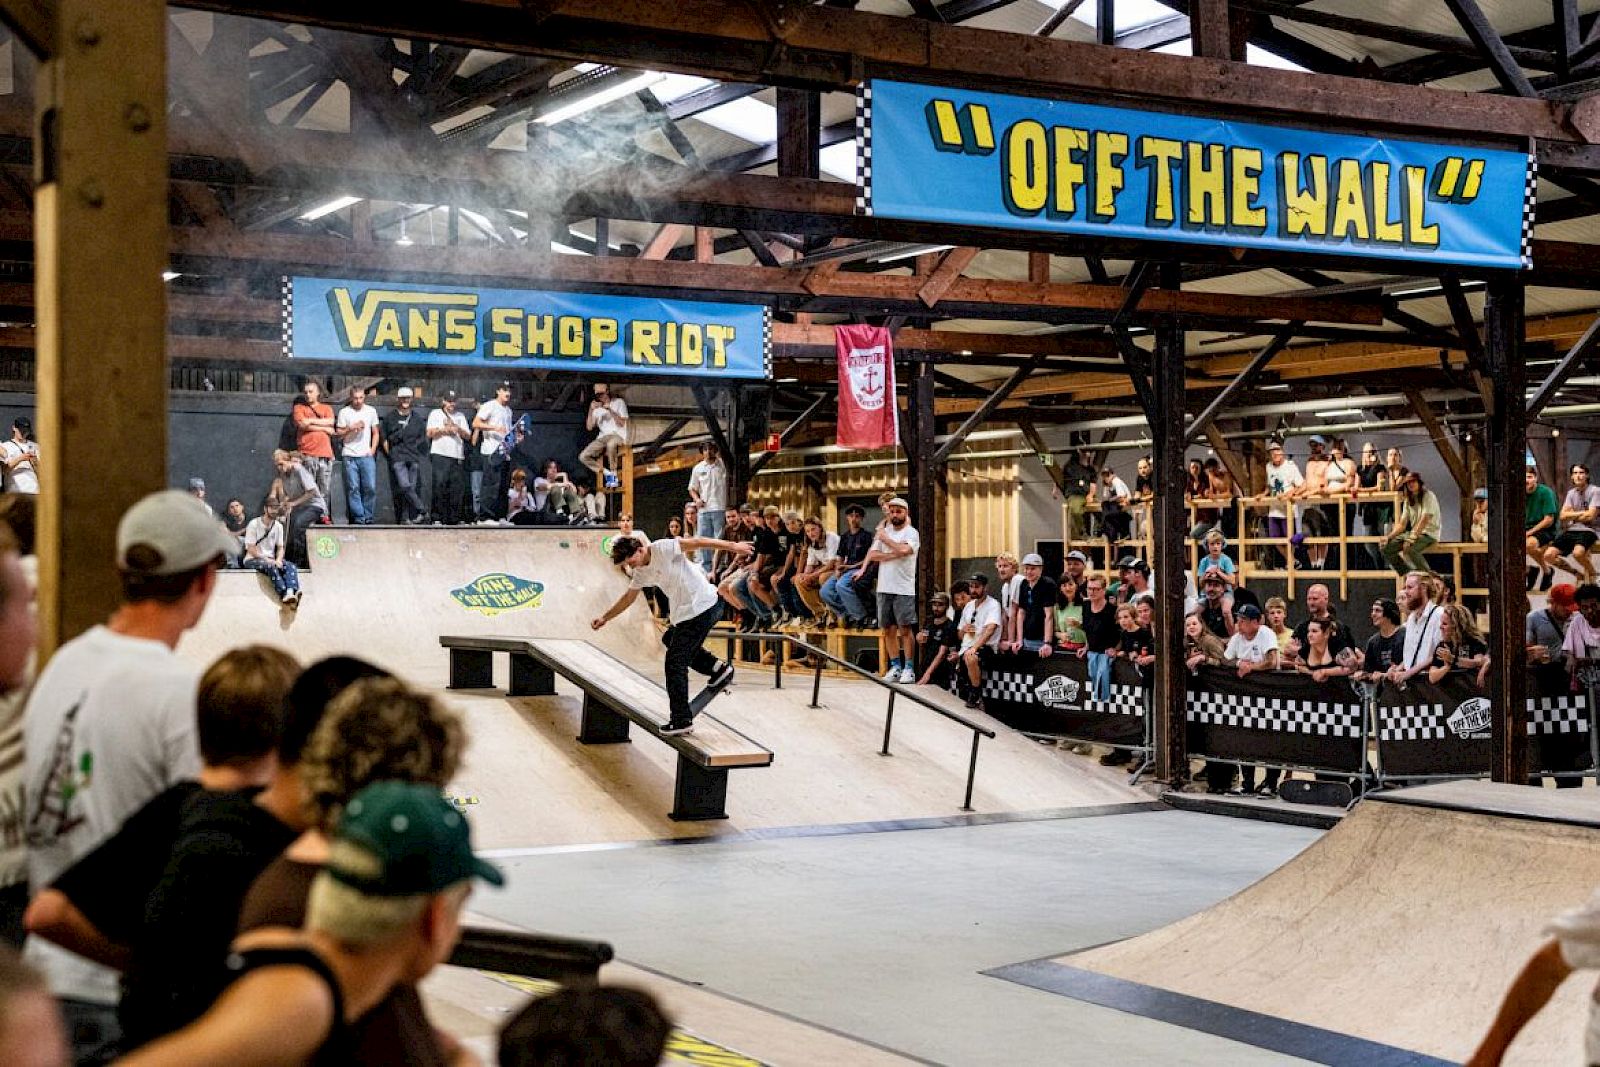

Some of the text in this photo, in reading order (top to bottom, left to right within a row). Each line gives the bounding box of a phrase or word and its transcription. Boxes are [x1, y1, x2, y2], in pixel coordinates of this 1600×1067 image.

[1135, 135, 1266, 236] THE
[326, 287, 736, 369] VANS SHOP RIOT
[472, 575, 515, 594] VANS
[488, 592, 517, 607] THE
[1460, 699, 1481, 715] VANS
[1465, 712, 1480, 728] THE
[1480, 707, 1491, 724] WA
